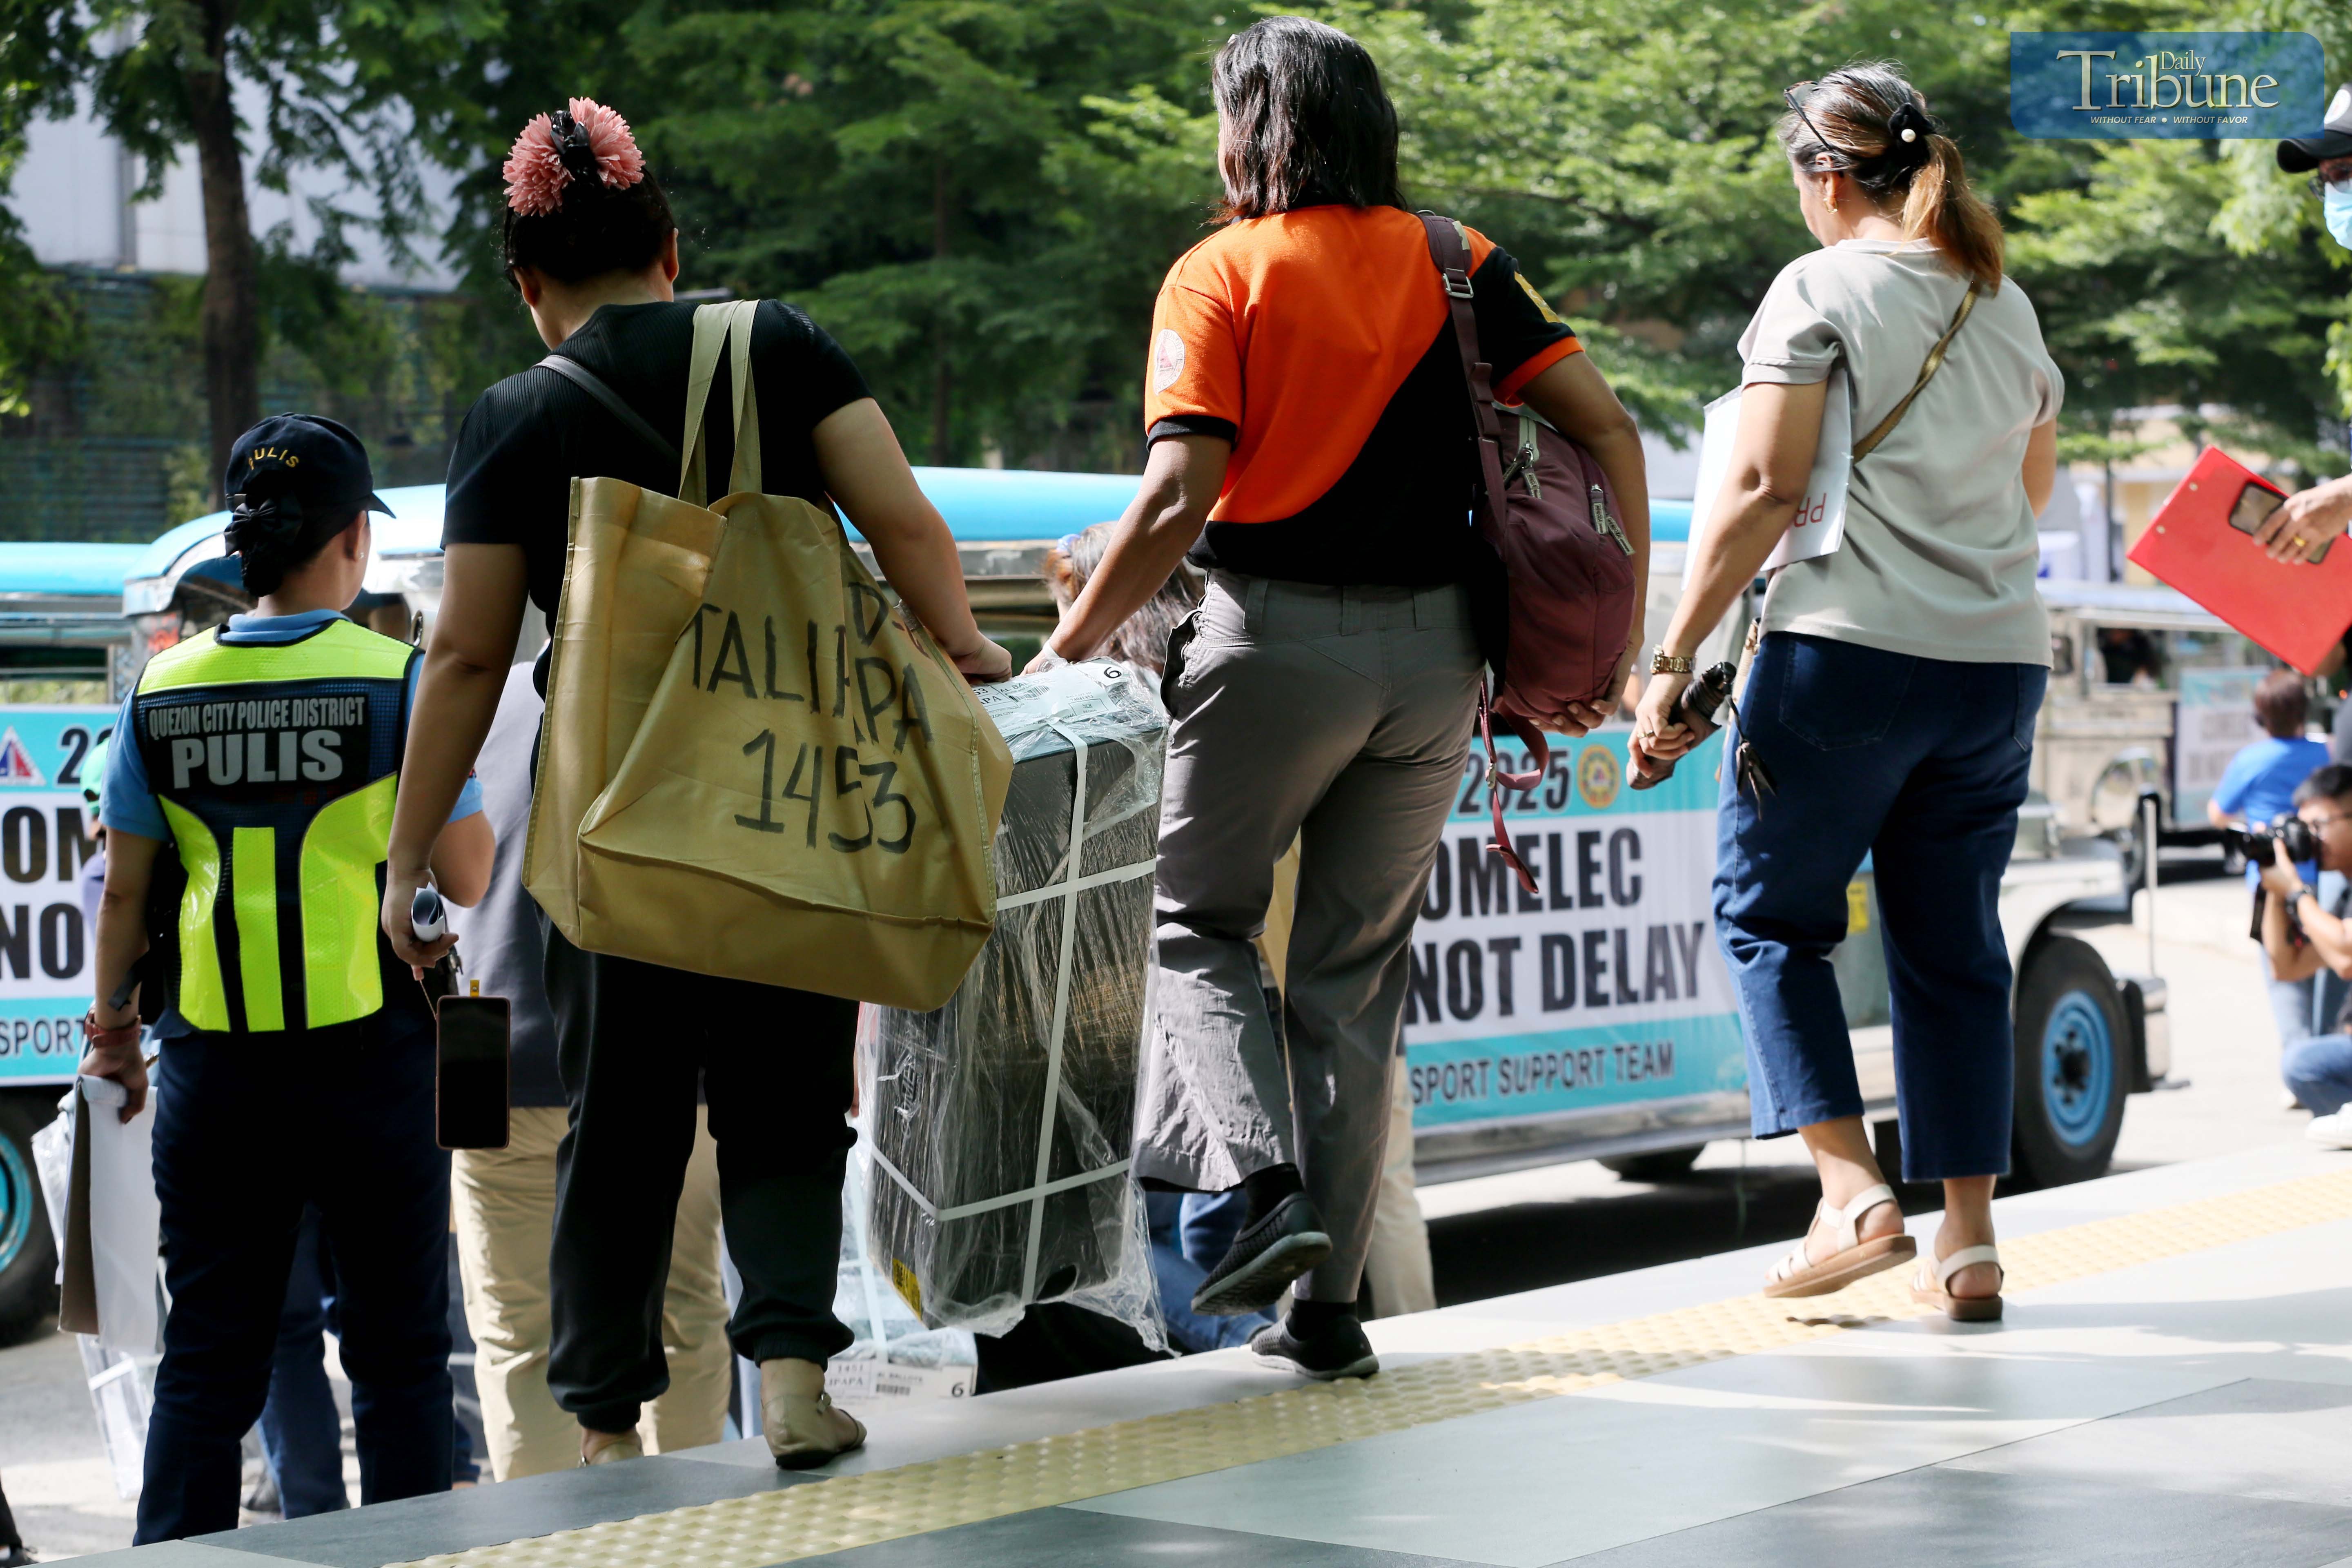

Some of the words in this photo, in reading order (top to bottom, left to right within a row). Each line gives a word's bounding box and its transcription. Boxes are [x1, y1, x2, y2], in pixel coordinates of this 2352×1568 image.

[1104, 666, 1122, 679] 6
[149, 706, 200, 740] QUEZON
[204, 702, 235, 733] CITY
[237, 699, 289, 729] POLICE
[292, 697, 365, 727] DISTRICT
[172, 730, 343, 789] PULIS
[734, 728, 917, 854] 1453
[1406, 936, 1522, 1025] NOT
[1540, 921, 1705, 1013] DELAY
[1498, 1047, 1606, 1096] SUPPORT
[1614, 1040, 1674, 1082] TEAM
[951, 1382, 965, 1397] 6
